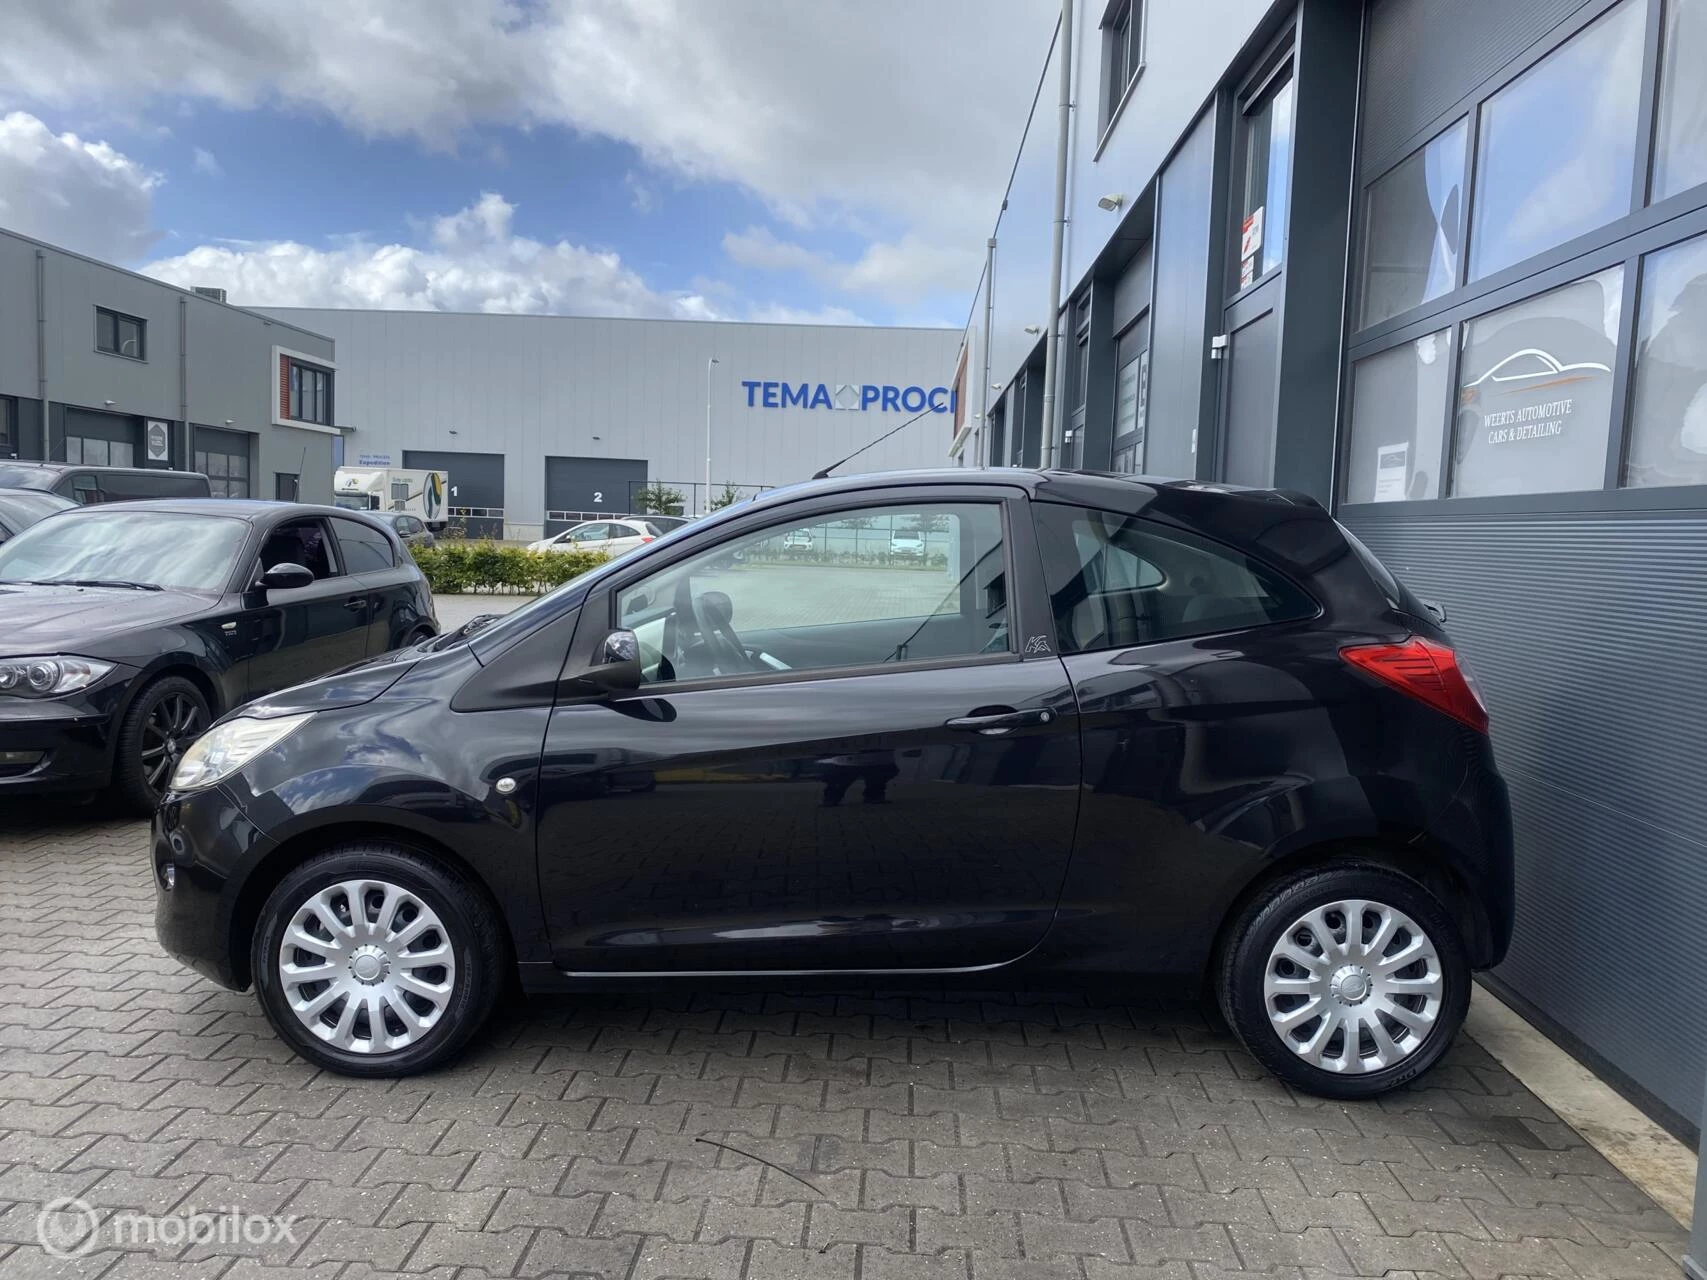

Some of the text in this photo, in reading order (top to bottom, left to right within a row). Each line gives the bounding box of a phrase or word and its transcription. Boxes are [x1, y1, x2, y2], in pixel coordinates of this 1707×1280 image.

[742, 381, 832, 409] TEMA
[1484, 399, 1572, 427] WEERTS AUTOMOTIVE
[1488, 421, 1562, 444] CARS & DETAILING
[451, 486, 458, 497] 1
[593, 491, 603, 503] 2
